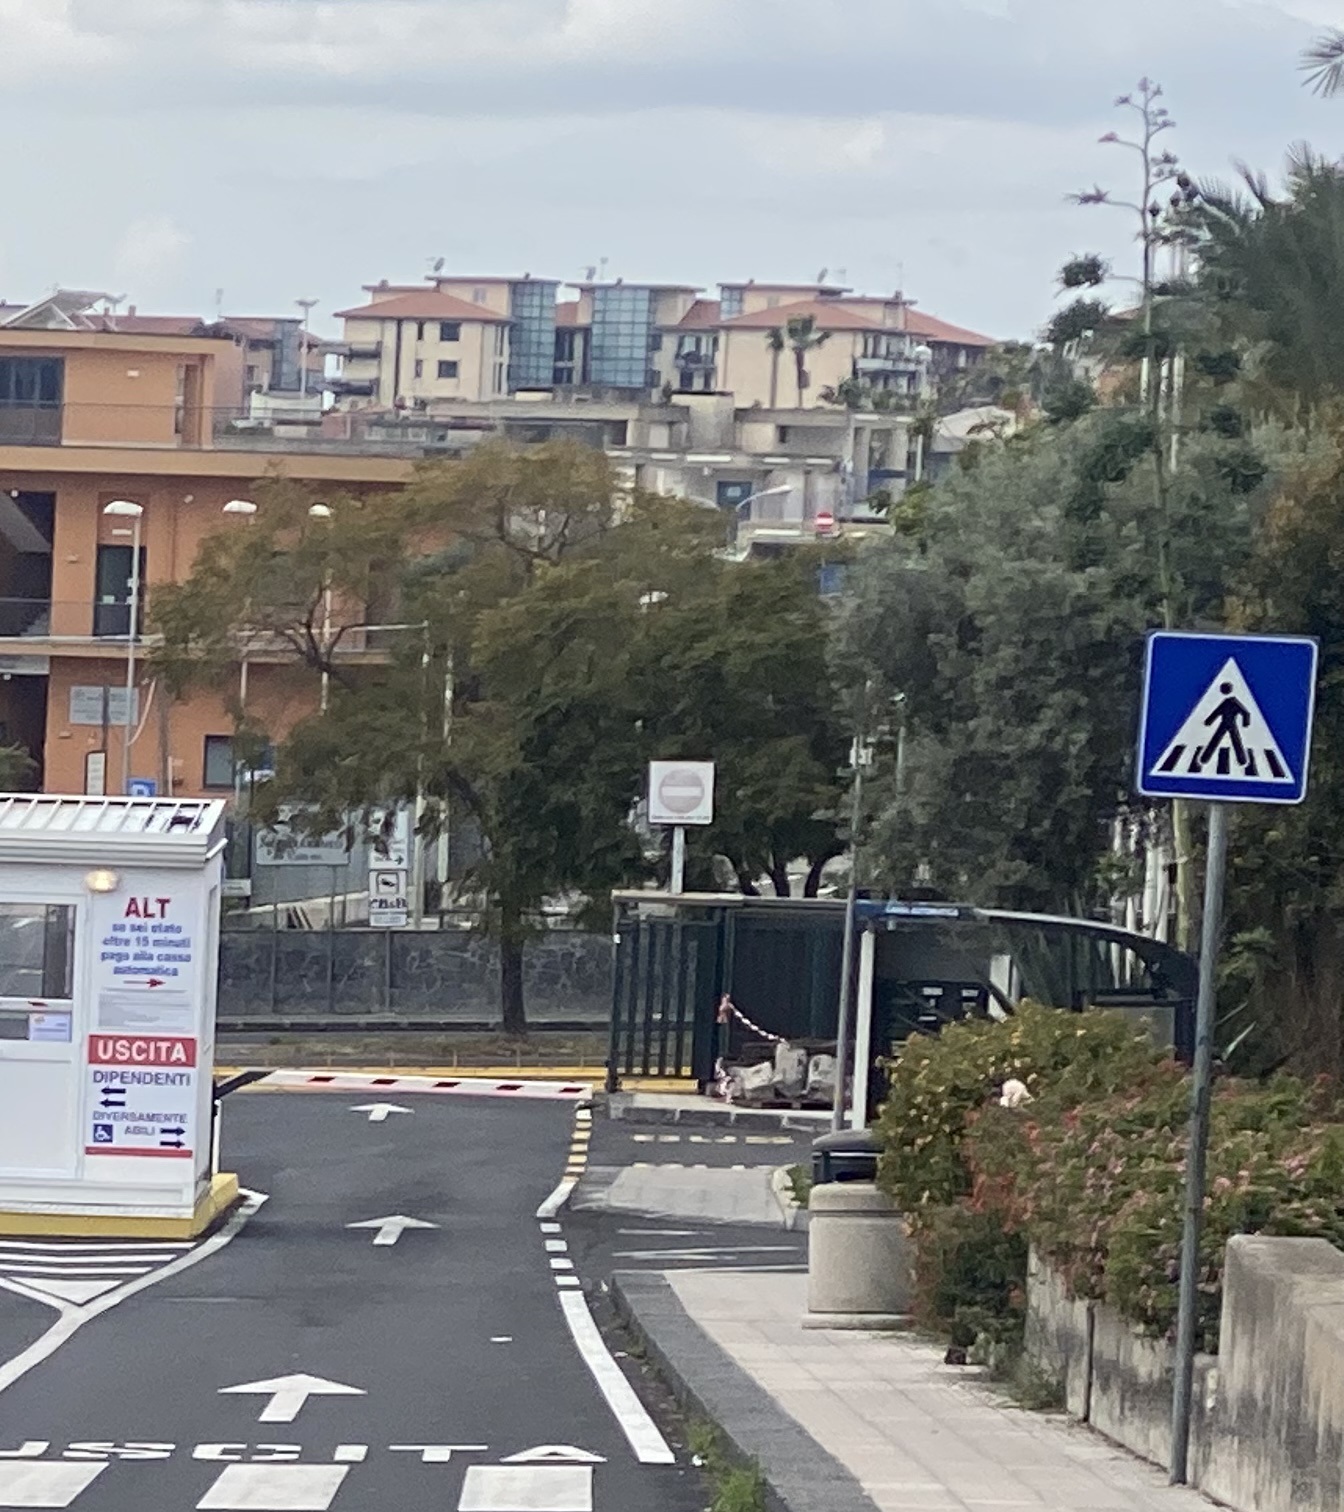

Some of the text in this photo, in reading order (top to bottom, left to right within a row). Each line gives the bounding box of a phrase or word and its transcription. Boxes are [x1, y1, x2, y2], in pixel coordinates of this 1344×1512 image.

[124, 896, 171, 919] ALT
[135, 936, 149, 947] 15
[97, 1039, 187, 1063] USCITA
[93, 1070, 191, 1086] DIPENDENTI
[92, 1111, 188, 1123] DIVERSAMENTE
[124, 1126, 155, 1136] ABILI
